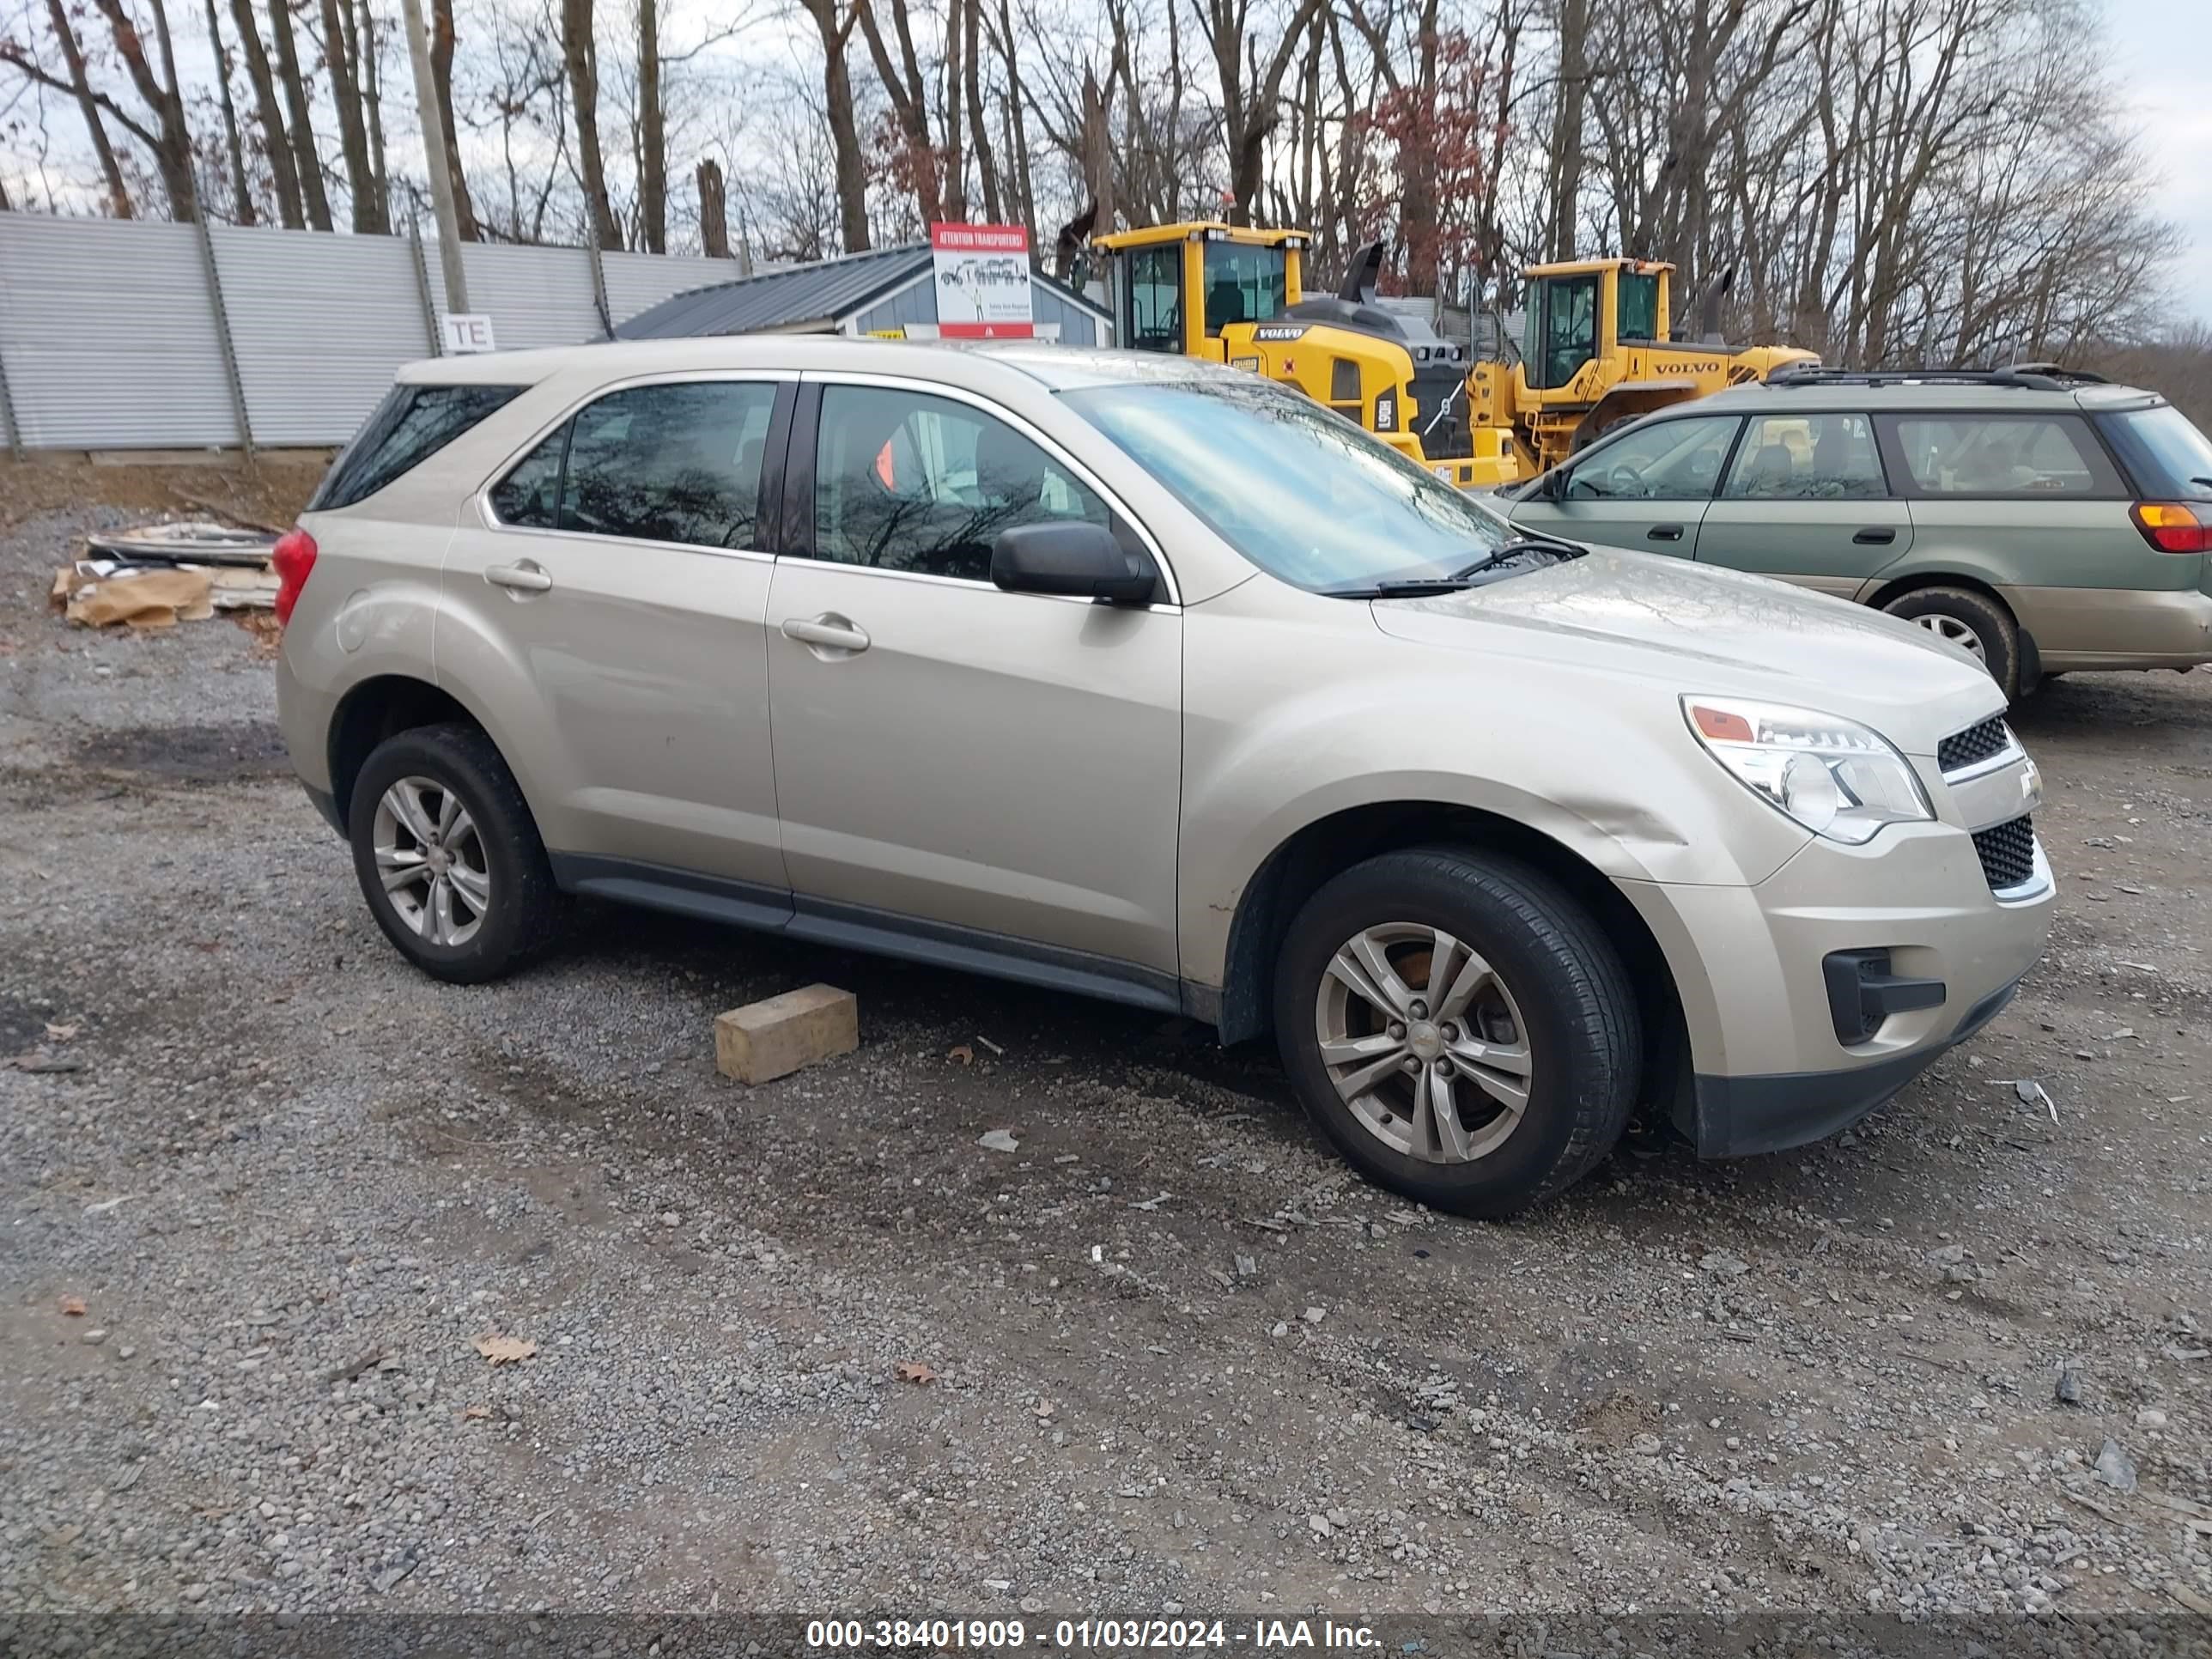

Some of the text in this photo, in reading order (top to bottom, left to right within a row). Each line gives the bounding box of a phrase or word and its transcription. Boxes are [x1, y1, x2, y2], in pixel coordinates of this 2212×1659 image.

[939, 232, 973, 246] ATTENTION
[450, 321, 487, 343] TE
[1260, 329, 1303, 338] VOLVO
[1656, 362, 1719, 374] VOLVO
